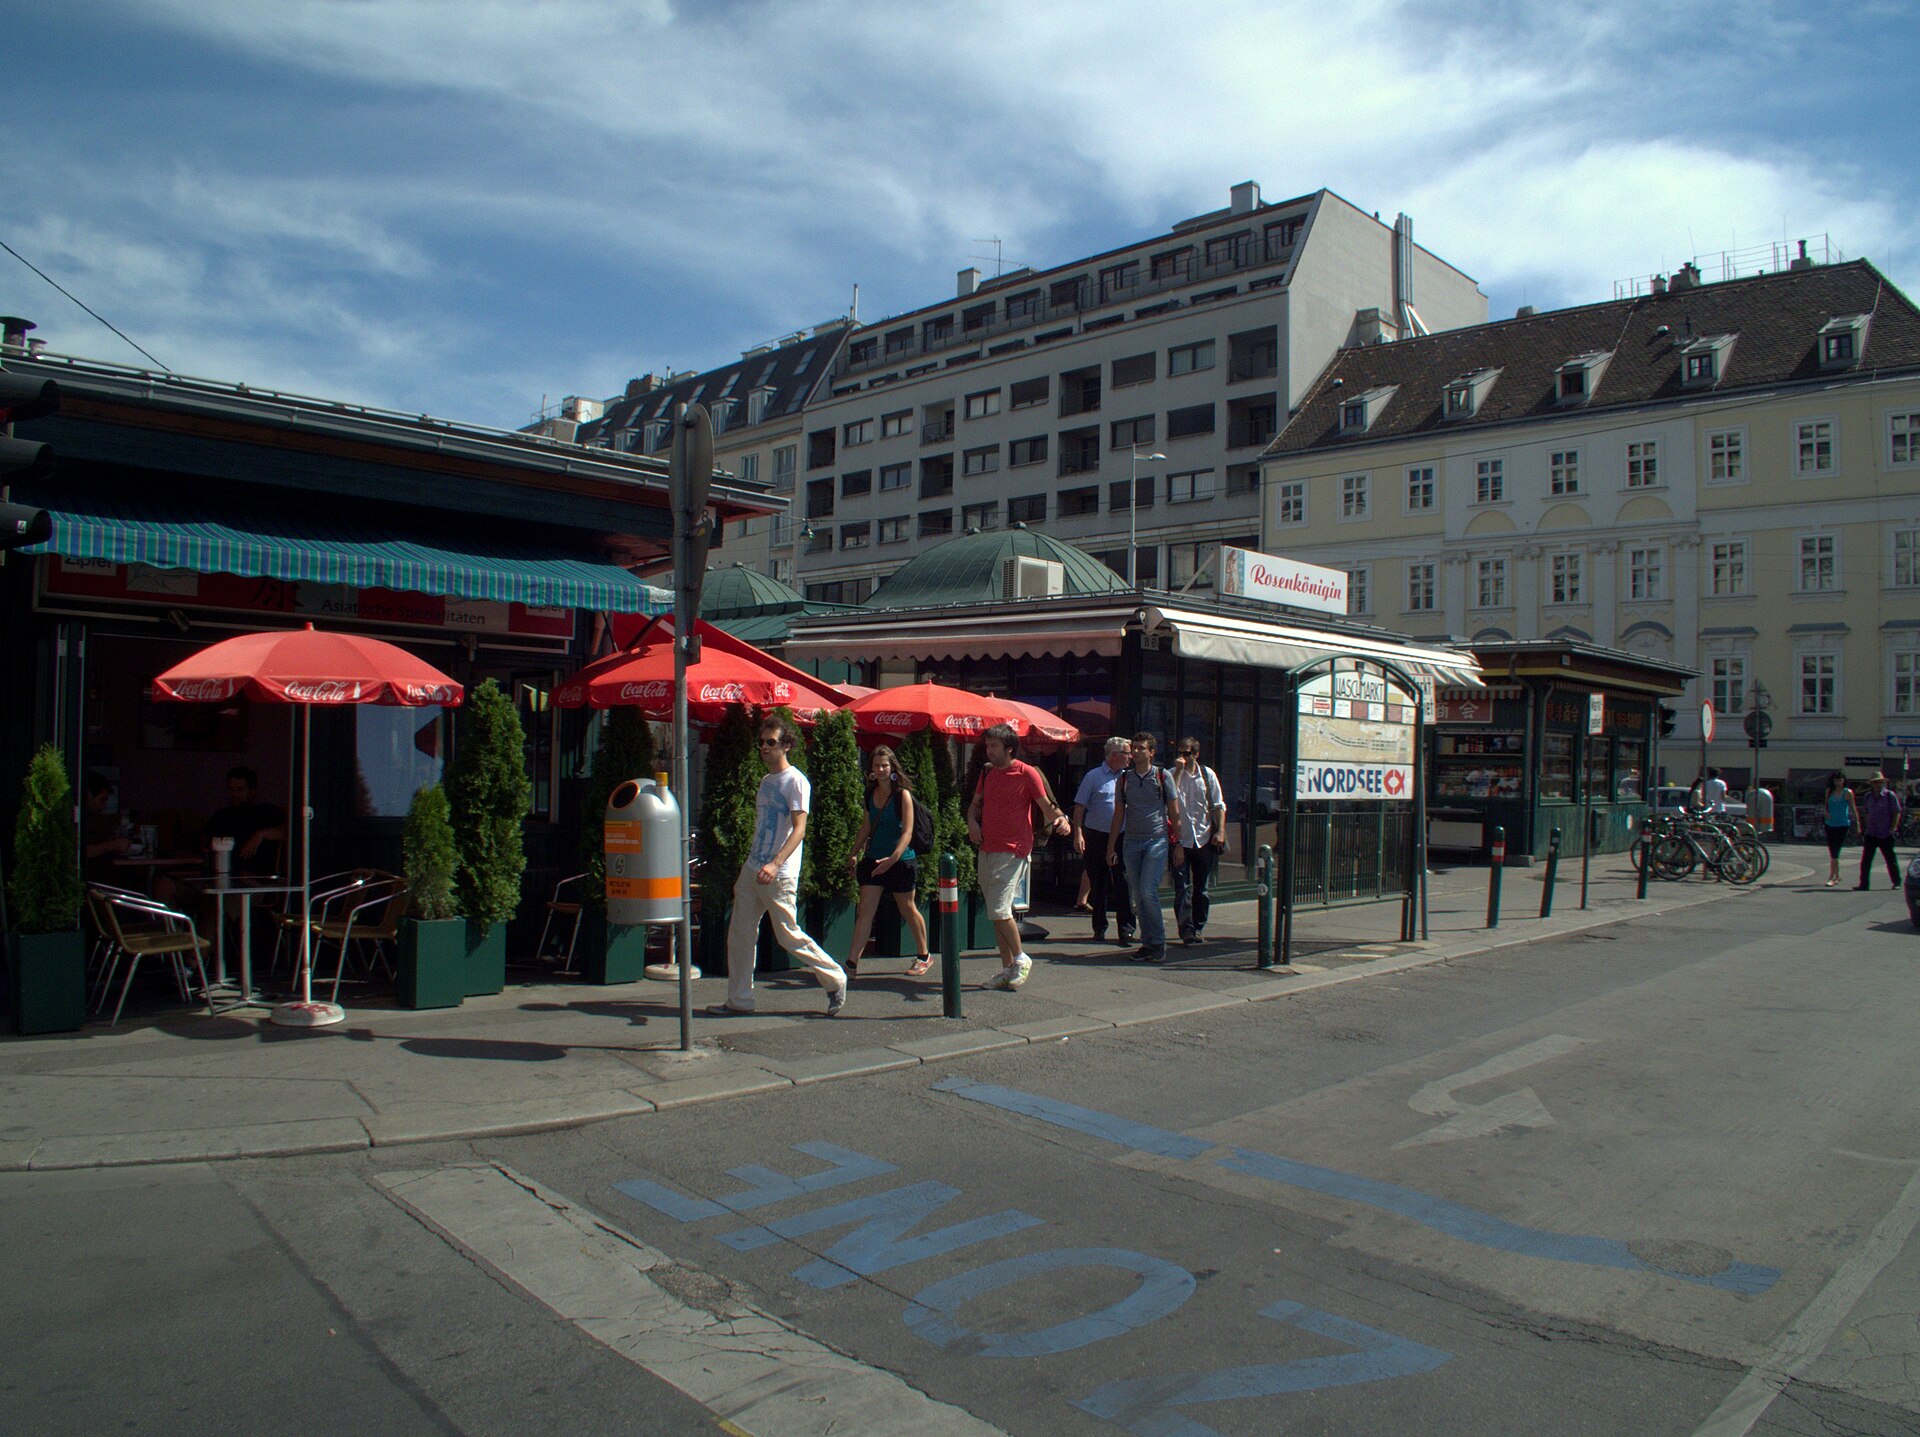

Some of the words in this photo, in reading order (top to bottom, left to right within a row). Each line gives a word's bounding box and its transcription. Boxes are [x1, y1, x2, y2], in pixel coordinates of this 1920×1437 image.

[1250, 563, 1342, 601] Rosenkönigin
[321, 599, 391, 616] Asiatische
[399, 605, 486, 624] Spezialitäten
[284, 681, 348, 701] Coca-Cola
[620, 680, 669, 700] Coca-Cola
[700, 683, 744, 701] Coca-Cola
[873, 711, 911, 726] Coca-Cola
[1307, 767, 1383, 793] NORDSEE
